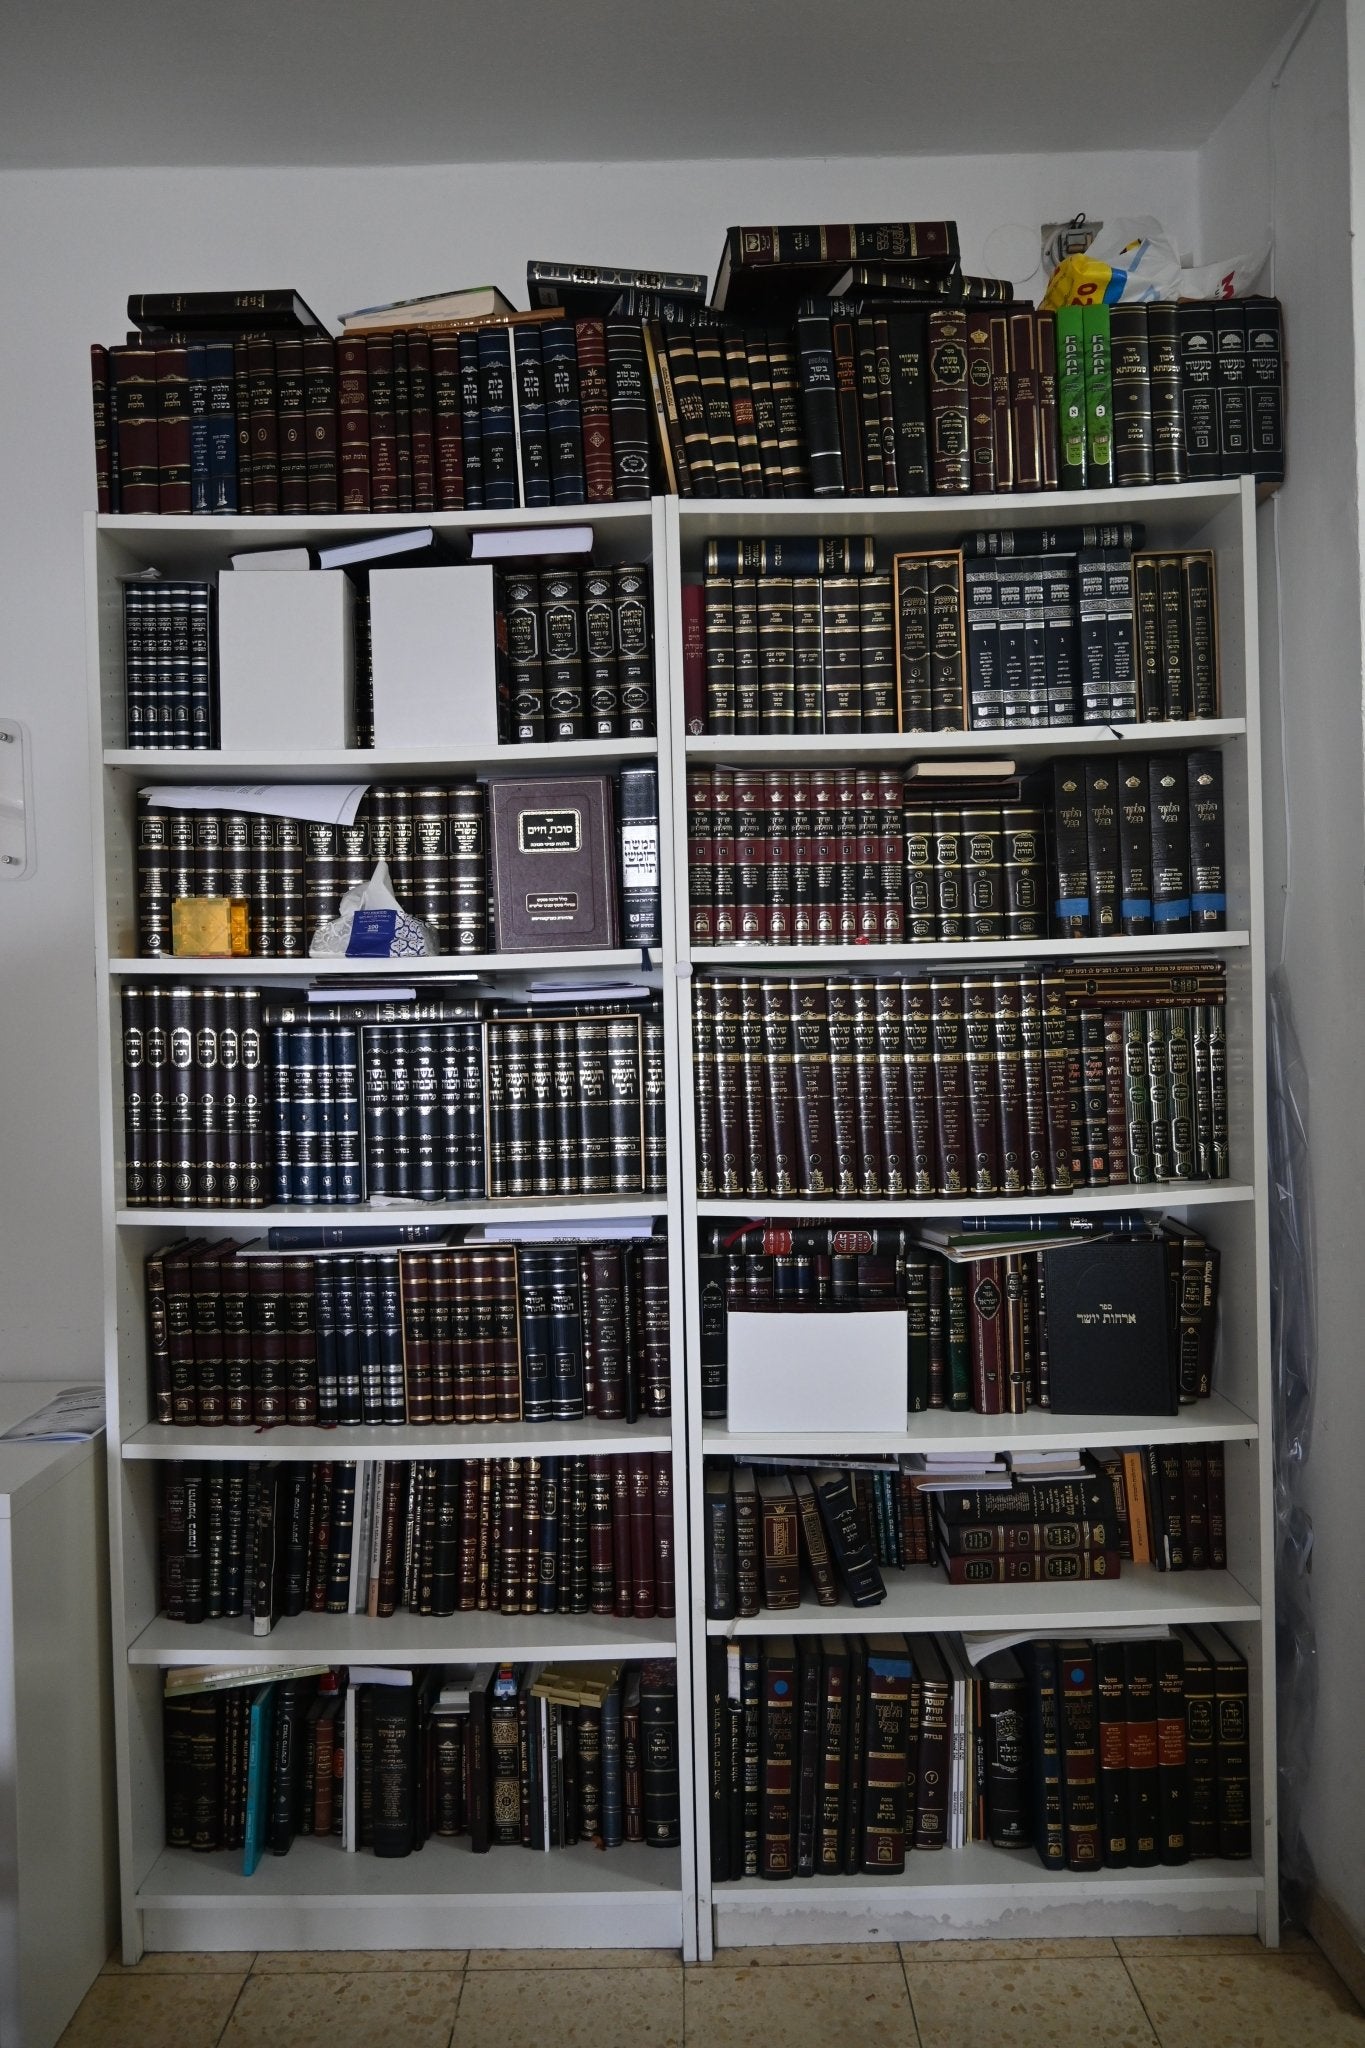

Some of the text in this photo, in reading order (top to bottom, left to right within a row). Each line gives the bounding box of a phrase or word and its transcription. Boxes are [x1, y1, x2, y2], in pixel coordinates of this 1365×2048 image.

[1065, 335, 1078, 376] הסוכה
[1092, 334, 1105, 375] הסוכה
[1185, 360, 1212, 370] מעשה
[1219, 358, 1245, 368] מעשה
[1252, 357, 1278, 368] מעשה
[810, 365, 827, 373] בשר
[1256, 369, 1275, 380] חמד
[554, 371, 570, 383] בית
[809, 373, 830, 382] בחלב
[1189, 371, 1209, 382] חמד
[1223, 370, 1243, 381] חמד
[488, 378, 504, 389] בית
[523, 376, 539, 387] בית
[593, 378, 607, 387] יום
[463, 383, 478, 394] בית
[524, 387, 540, 398] דוד
[555, 382, 570, 394] דוד
[312, 395, 327, 404] שבת
[464, 395, 478, 405] דוד
[488, 389, 503, 400] דוד
[254, 397, 269, 406] שבת
[284, 398, 299, 407] שבת
[527, 825, 573, 835] סוכת חיים
[1015, 841, 1033, 849] משנה
[716, 1022, 736, 1036] שלחן
[798, 1022, 820, 1036] שלחן
[936, 1022, 958, 1036] שלחן
[1044, 1019, 1066, 1031] שלחן
[716, 1035, 736, 1047] ערוך
[799, 1035, 820, 1047] ערוך
[937, 1035, 957, 1046] ערוך
[1045, 1031, 1065, 1042] ערוך
[366, 1068, 387, 1079] משך
[413, 1067, 435, 1079] משך
[505, 1071, 529, 1086] העמק
[579, 1069, 605, 1087] העמק
[611, 1068, 637, 1083] העמק
[366, 1080, 389, 1091] חכמה
[412, 1080, 438, 1090] חכמה
[583, 1084, 603, 1096] דבר
[614, 1082, 634, 1095] דבר
[508, 1086, 527, 1099] דבר
[839, 1233, 848, 1252] יעקב
[1098, 1303, 1112, 1312] ספר
[1076, 1312, 1136, 1325] ארחות יושר
[187, 1488, 198, 1547] החשמל בשבת
[879, 1803, 894, 1811] בבא
[876, 1812, 896, 1820] בתרא
